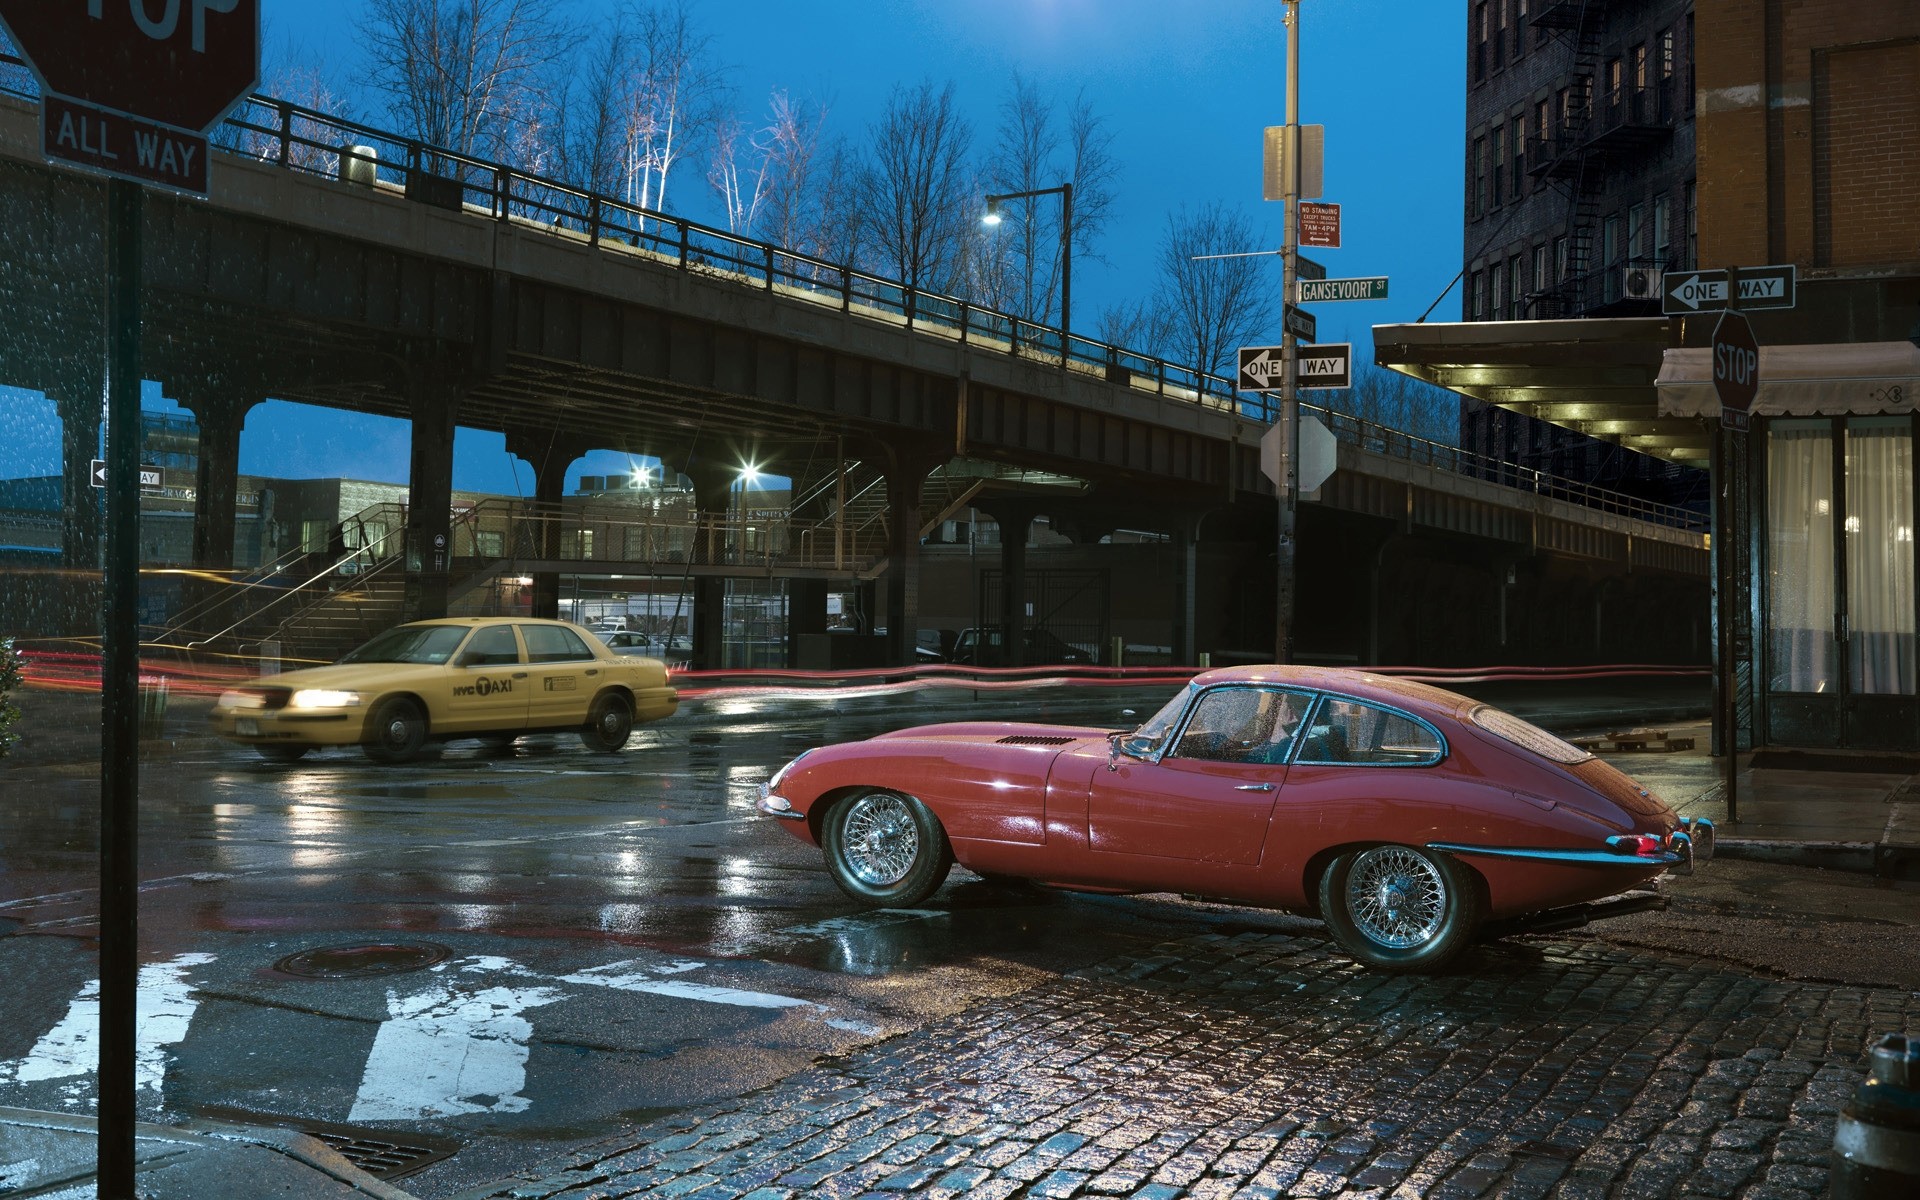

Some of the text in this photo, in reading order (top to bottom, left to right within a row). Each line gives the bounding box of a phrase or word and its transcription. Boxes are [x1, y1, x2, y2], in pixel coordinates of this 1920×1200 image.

[56, 109, 197, 178] ALL WAY
[1302, 280, 1386, 300] GANSEVOORT ST
[1683, 280, 1776, 299] ONE WAY
[1249, 359, 1338, 376] ONE WAY
[1716, 342, 1756, 385] STOP
[1723, 412, 1734, 425] ALL
[140, 473, 155, 484] AY
[453, 677, 512, 696] NYC TAXI
